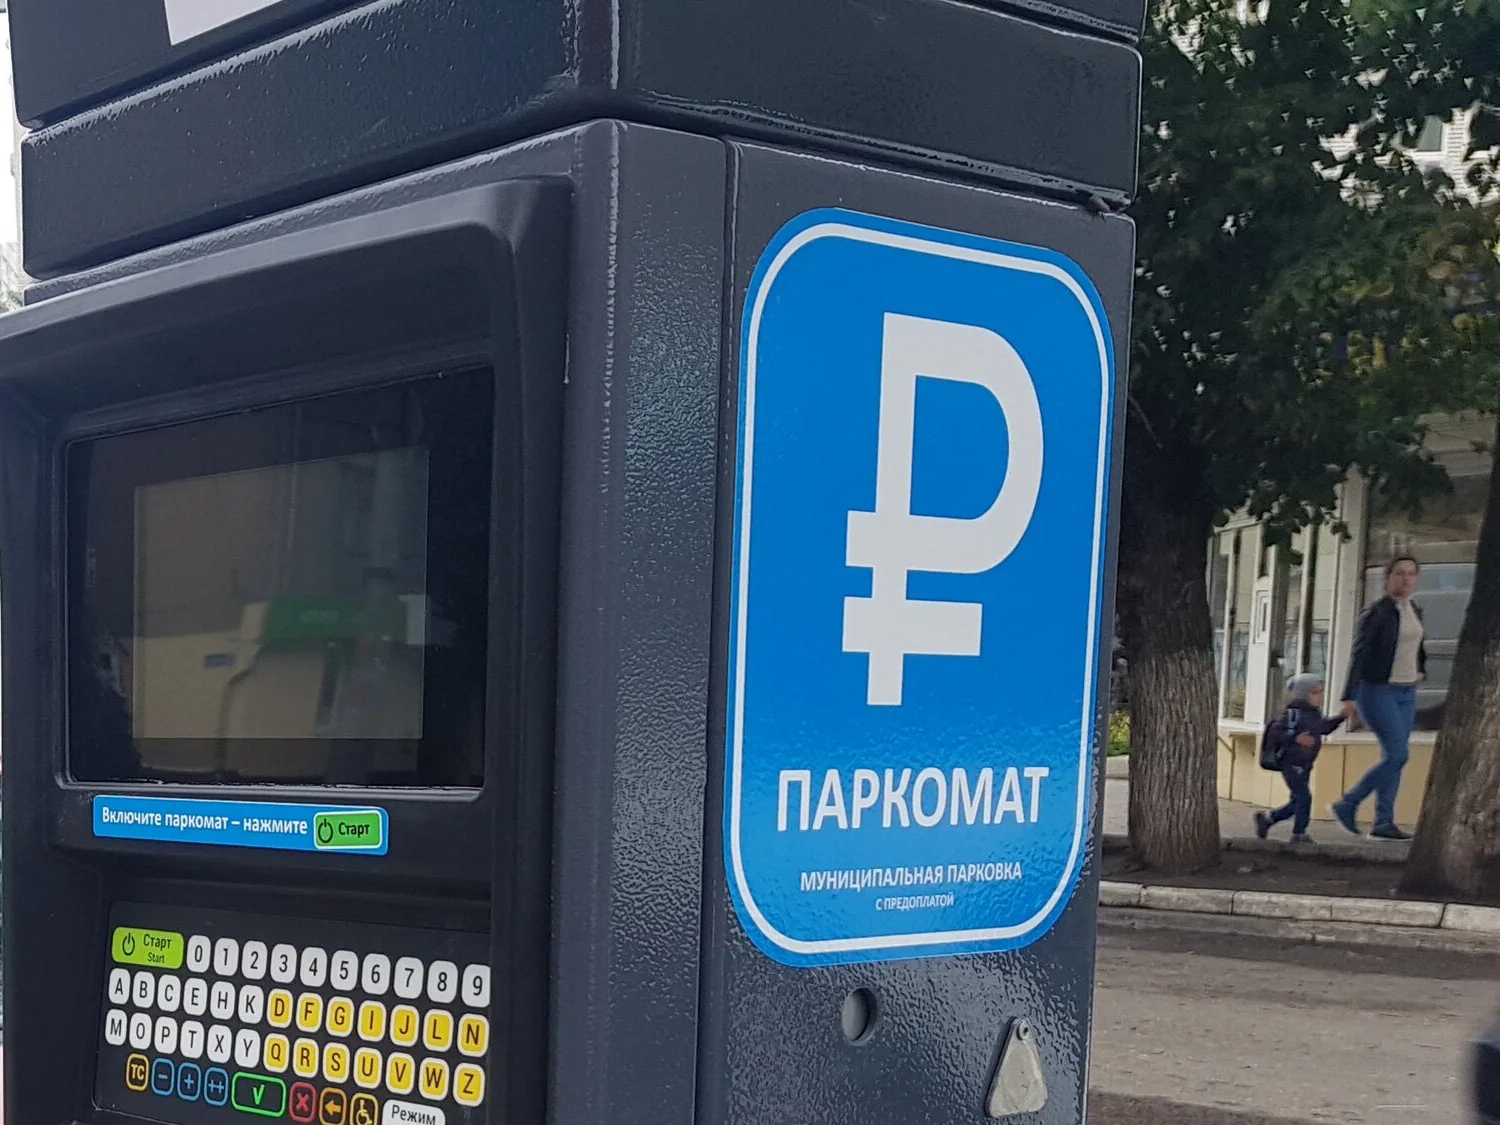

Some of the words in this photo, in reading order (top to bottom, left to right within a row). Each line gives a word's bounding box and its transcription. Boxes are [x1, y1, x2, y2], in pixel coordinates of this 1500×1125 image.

[778, 767, 1049, 831] ПАРКОМАТ
[103, 807, 162, 826] Включите
[165, 814, 229, 831] паркомат
[243, 818, 308, 834] нажмите
[338, 822, 370, 838] Старт
[800, 864, 944, 892] МУНИЦИПАЛЬНАЯ
[948, 860, 1022, 884] ПАРКОВКА
[876, 897, 882, 911] С
[883, 890, 954, 910] ПРЕДОПЛАТОЙ
[144, 934, 172, 950] Старт
[146, 952, 164, 966] Start
[195, 945, 202, 962] 0
[224, 948, 228, 966] 1
[250, 951, 258, 969] 2
[279, 954, 288, 972] 3
[309, 958, 317, 976] 4
[340, 961, 348, 980] 5
[372, 964, 380, 983] 6
[405, 968, 414, 987] 7
[438, 972, 447, 991] 8
[473, 976, 482, 996] 9
[115, 978, 123, 994] A
[140, 980, 147, 998] B
[165, 984, 173, 1002] C
[192, 988, 199, 1006] E
[218, 991, 228, 1009] H
[246, 995, 255, 1014] K
[274, 998, 284, 1016] D
[305, 1002, 314, 1020] F
[335, 1006, 345, 1025] G
[400, 1016, 409, 1034] J
[433, 1019, 441, 1039] L
[466, 1024, 479, 1044] N
[110, 1018, 122, 1036] M
[136, 1023, 145, 1039] O
[162, 1026, 170, 1043] P
[189, 1030, 197, 1048] T
[215, 1034, 224, 1053] X
[244, 1039, 252, 1057] Y
[271, 1043, 280, 1061] Q
[301, 1048, 310, 1067] R
[331, 1053, 340, 1071] S
[362, 1057, 373, 1076] U
[395, 1062, 406, 1082] V
[426, 1067, 442, 1088] W
[463, 1073, 474, 1094] Z
[392, 1100, 437, 1125] Режим
